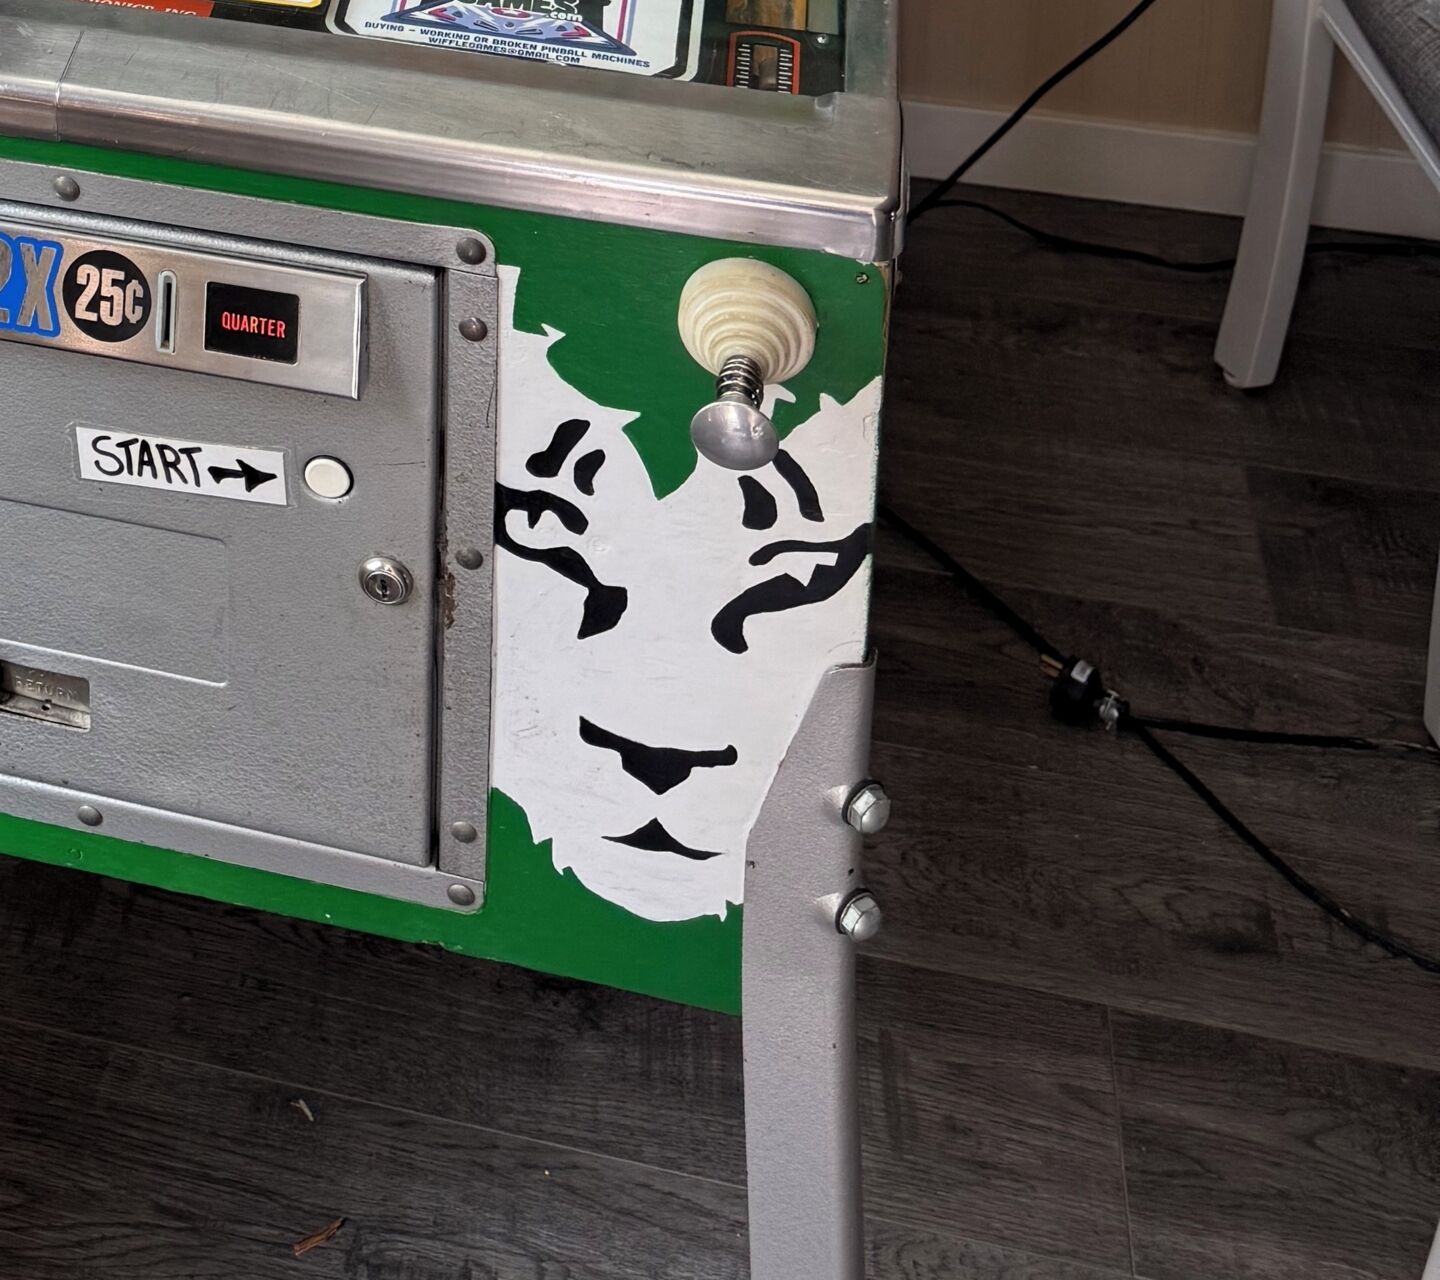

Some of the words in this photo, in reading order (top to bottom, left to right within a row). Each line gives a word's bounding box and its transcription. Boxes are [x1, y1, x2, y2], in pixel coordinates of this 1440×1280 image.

[546, 11, 583, 22] .com
[364, 21, 404, 32] BUYING
[420, 28, 472, 41] WORKING
[474, 35, 489, 43] OR
[492, 38, 538, 51] BROKEN
[543, 45, 587, 58] PINBALL
[591, 52, 650, 68] MACHINES
[74, 262, 145, 328] 25¢
[221, 311, 287, 340] QUARTER
[90, 434, 204, 488] START
